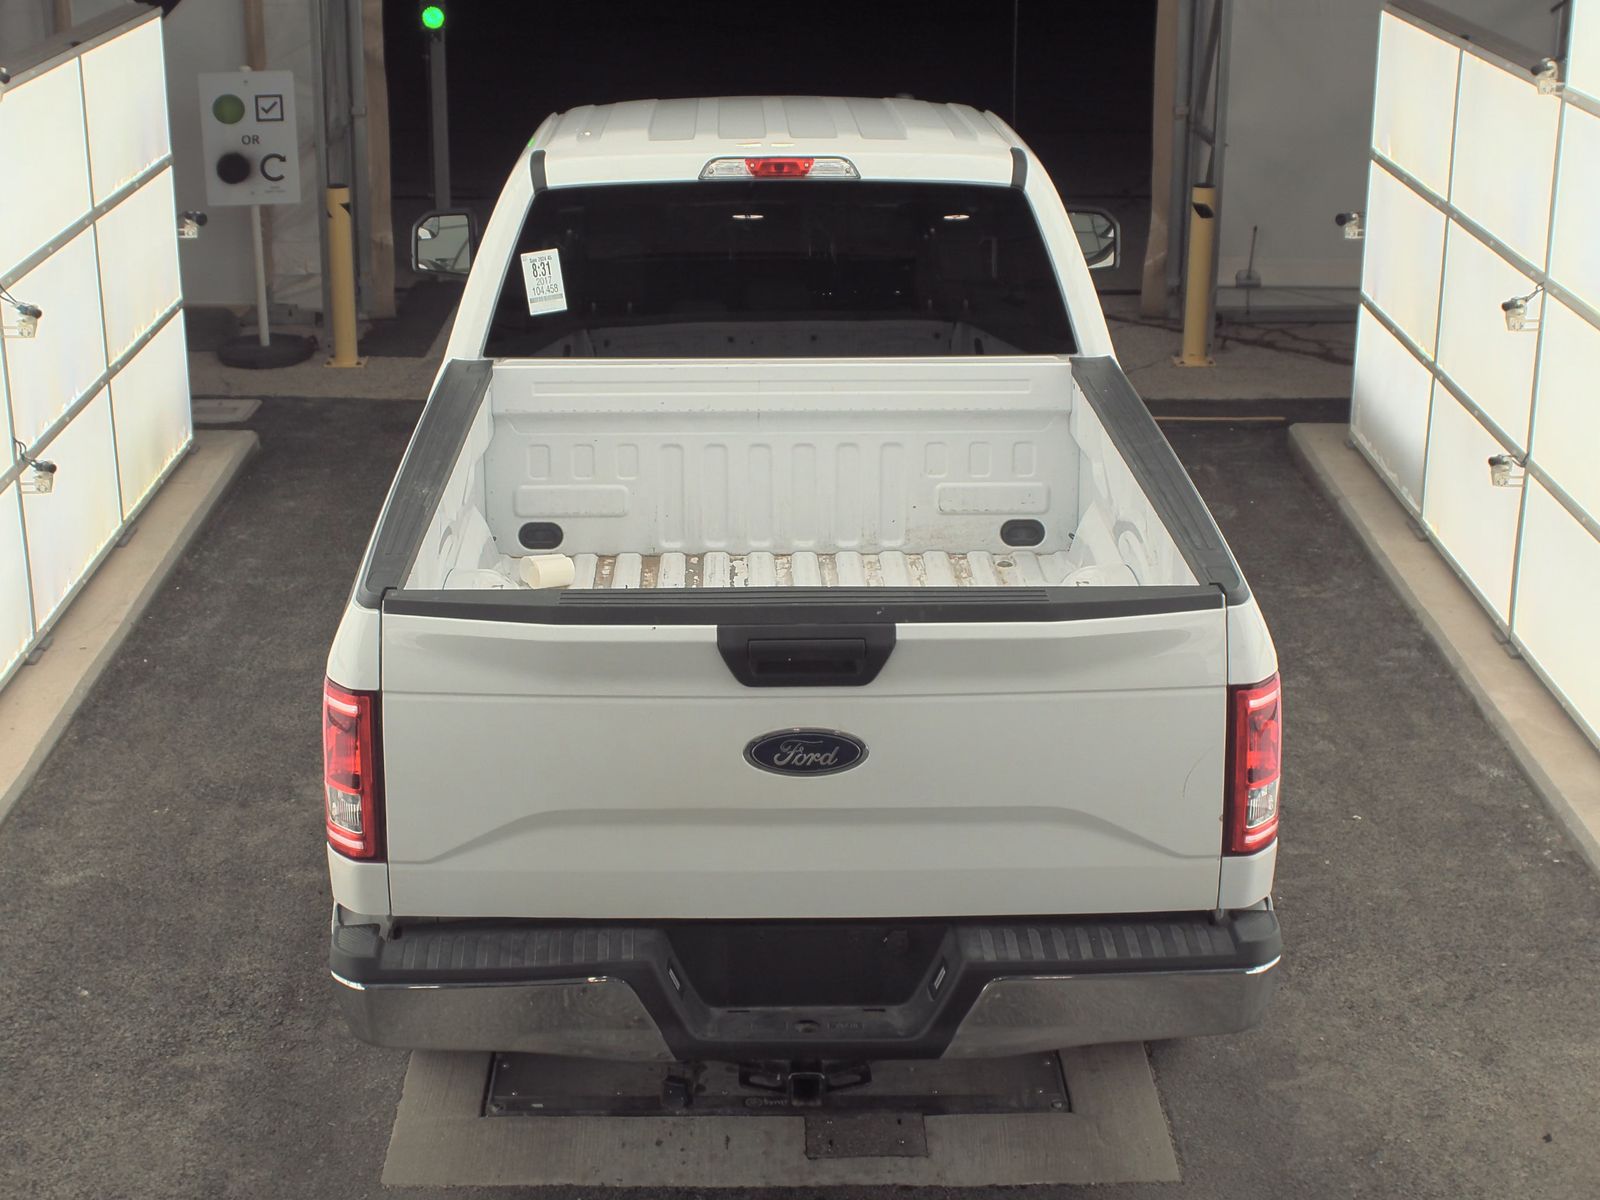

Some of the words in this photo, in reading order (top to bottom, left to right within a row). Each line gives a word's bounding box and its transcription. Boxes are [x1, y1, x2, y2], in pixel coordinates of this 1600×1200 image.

[241, 134, 260, 145] OR
[532, 261, 551, 278] 8:31
[536, 276, 552, 286] 2017
[773, 739, 840, 766] Ford
